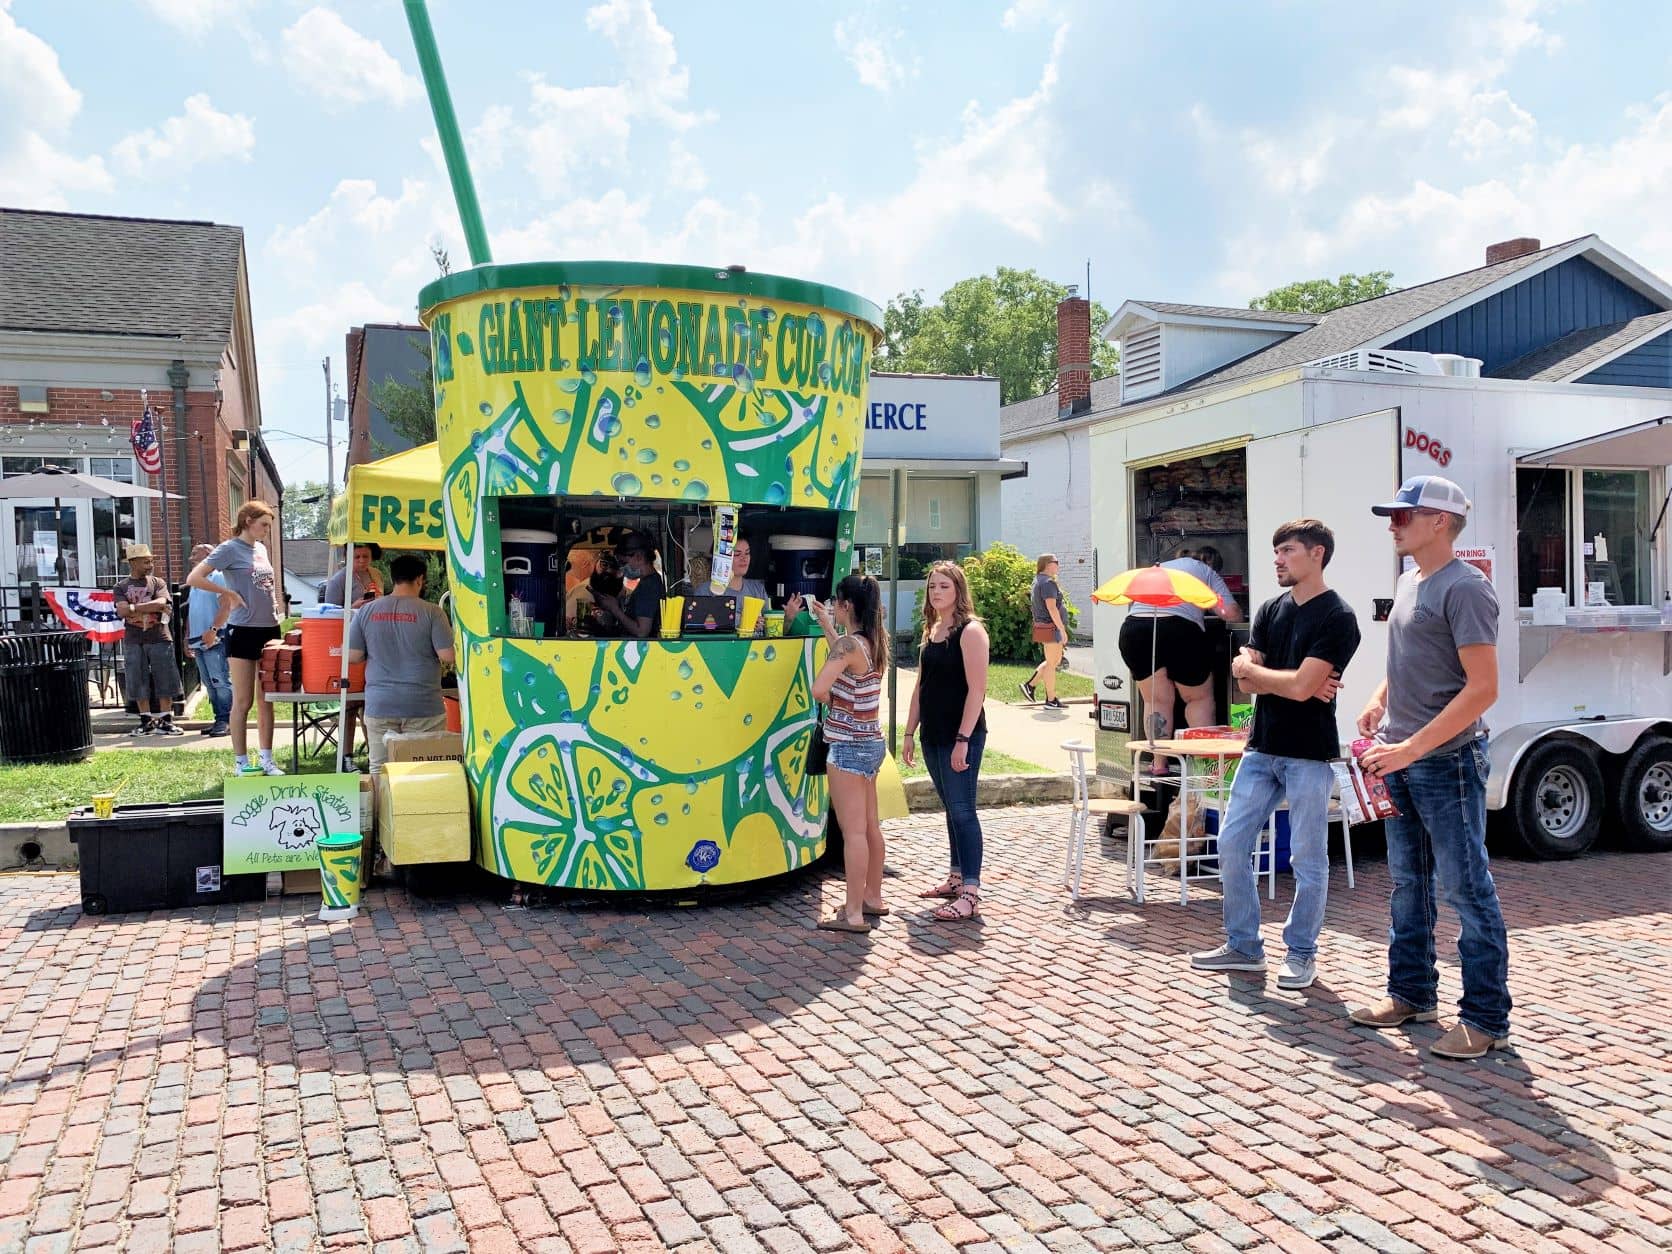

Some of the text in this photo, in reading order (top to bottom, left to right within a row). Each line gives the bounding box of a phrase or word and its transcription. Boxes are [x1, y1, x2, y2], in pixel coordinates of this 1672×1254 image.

[479, 297, 567, 375] GIANT
[575, 297, 769, 381] LEMONADE
[1405, 428, 1452, 467] DOGS
[361, 494, 445, 539] FRES
[1467, 549, 1486, 558] RINGS
[270, 782, 308, 801] Drink
[312, 785, 351, 822] Station
[245, 851, 259, 864] All
[262, 852, 282, 864] Pets
[285, 854, 302, 863] are
